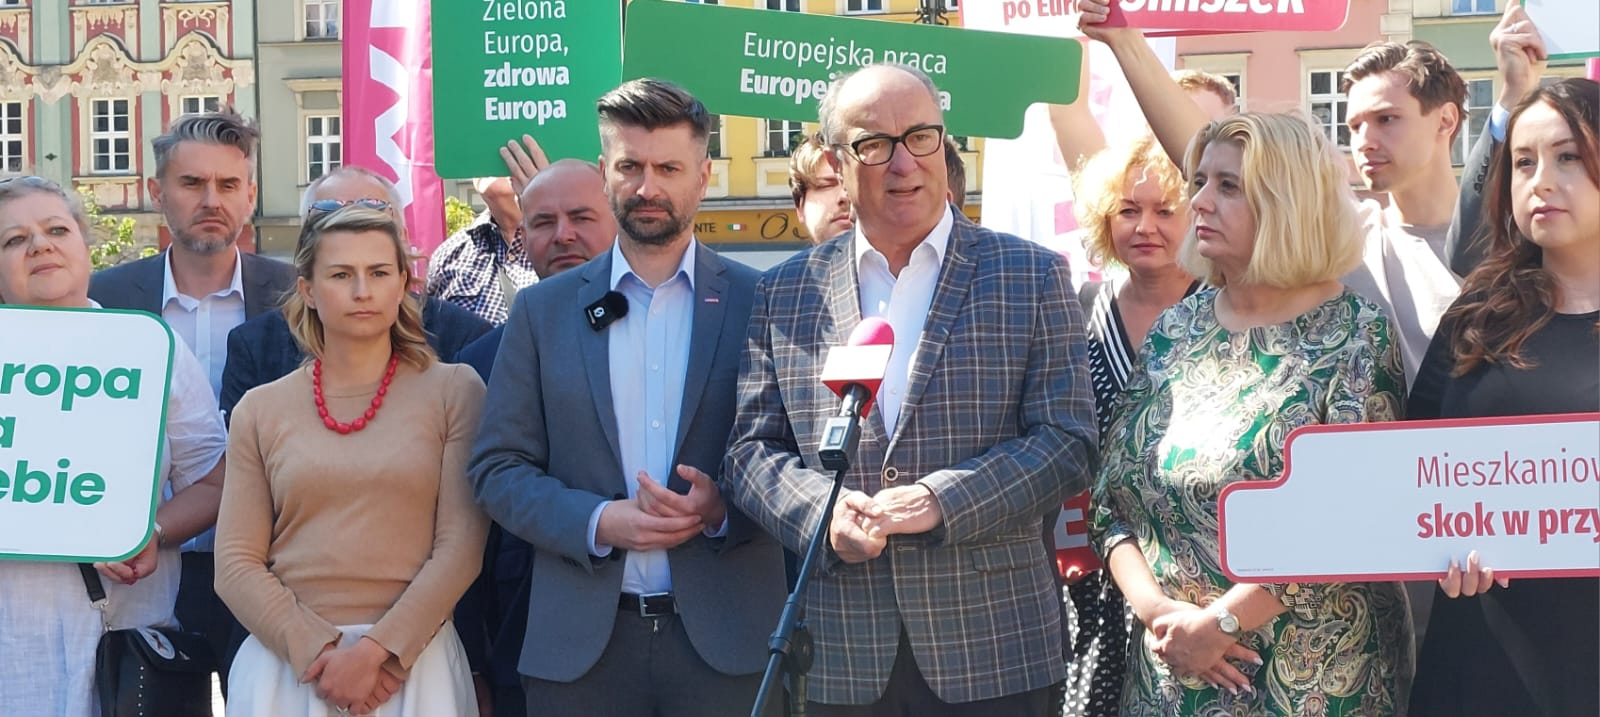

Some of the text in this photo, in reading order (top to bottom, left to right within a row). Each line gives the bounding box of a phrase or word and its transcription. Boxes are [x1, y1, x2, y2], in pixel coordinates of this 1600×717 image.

[482, 0, 566, 21] Zielona
[1003, 0, 1031, 26] po
[484, 31, 568, 59] Europa,
[744, 31, 874, 70] Europejska
[484, 62, 569, 88] zdrowa
[740, 67, 836, 105] Europe
[485, 97, 567, 126] Europa
[1417, 502, 1496, 539] skok
[1502, 510, 1530, 536] w
